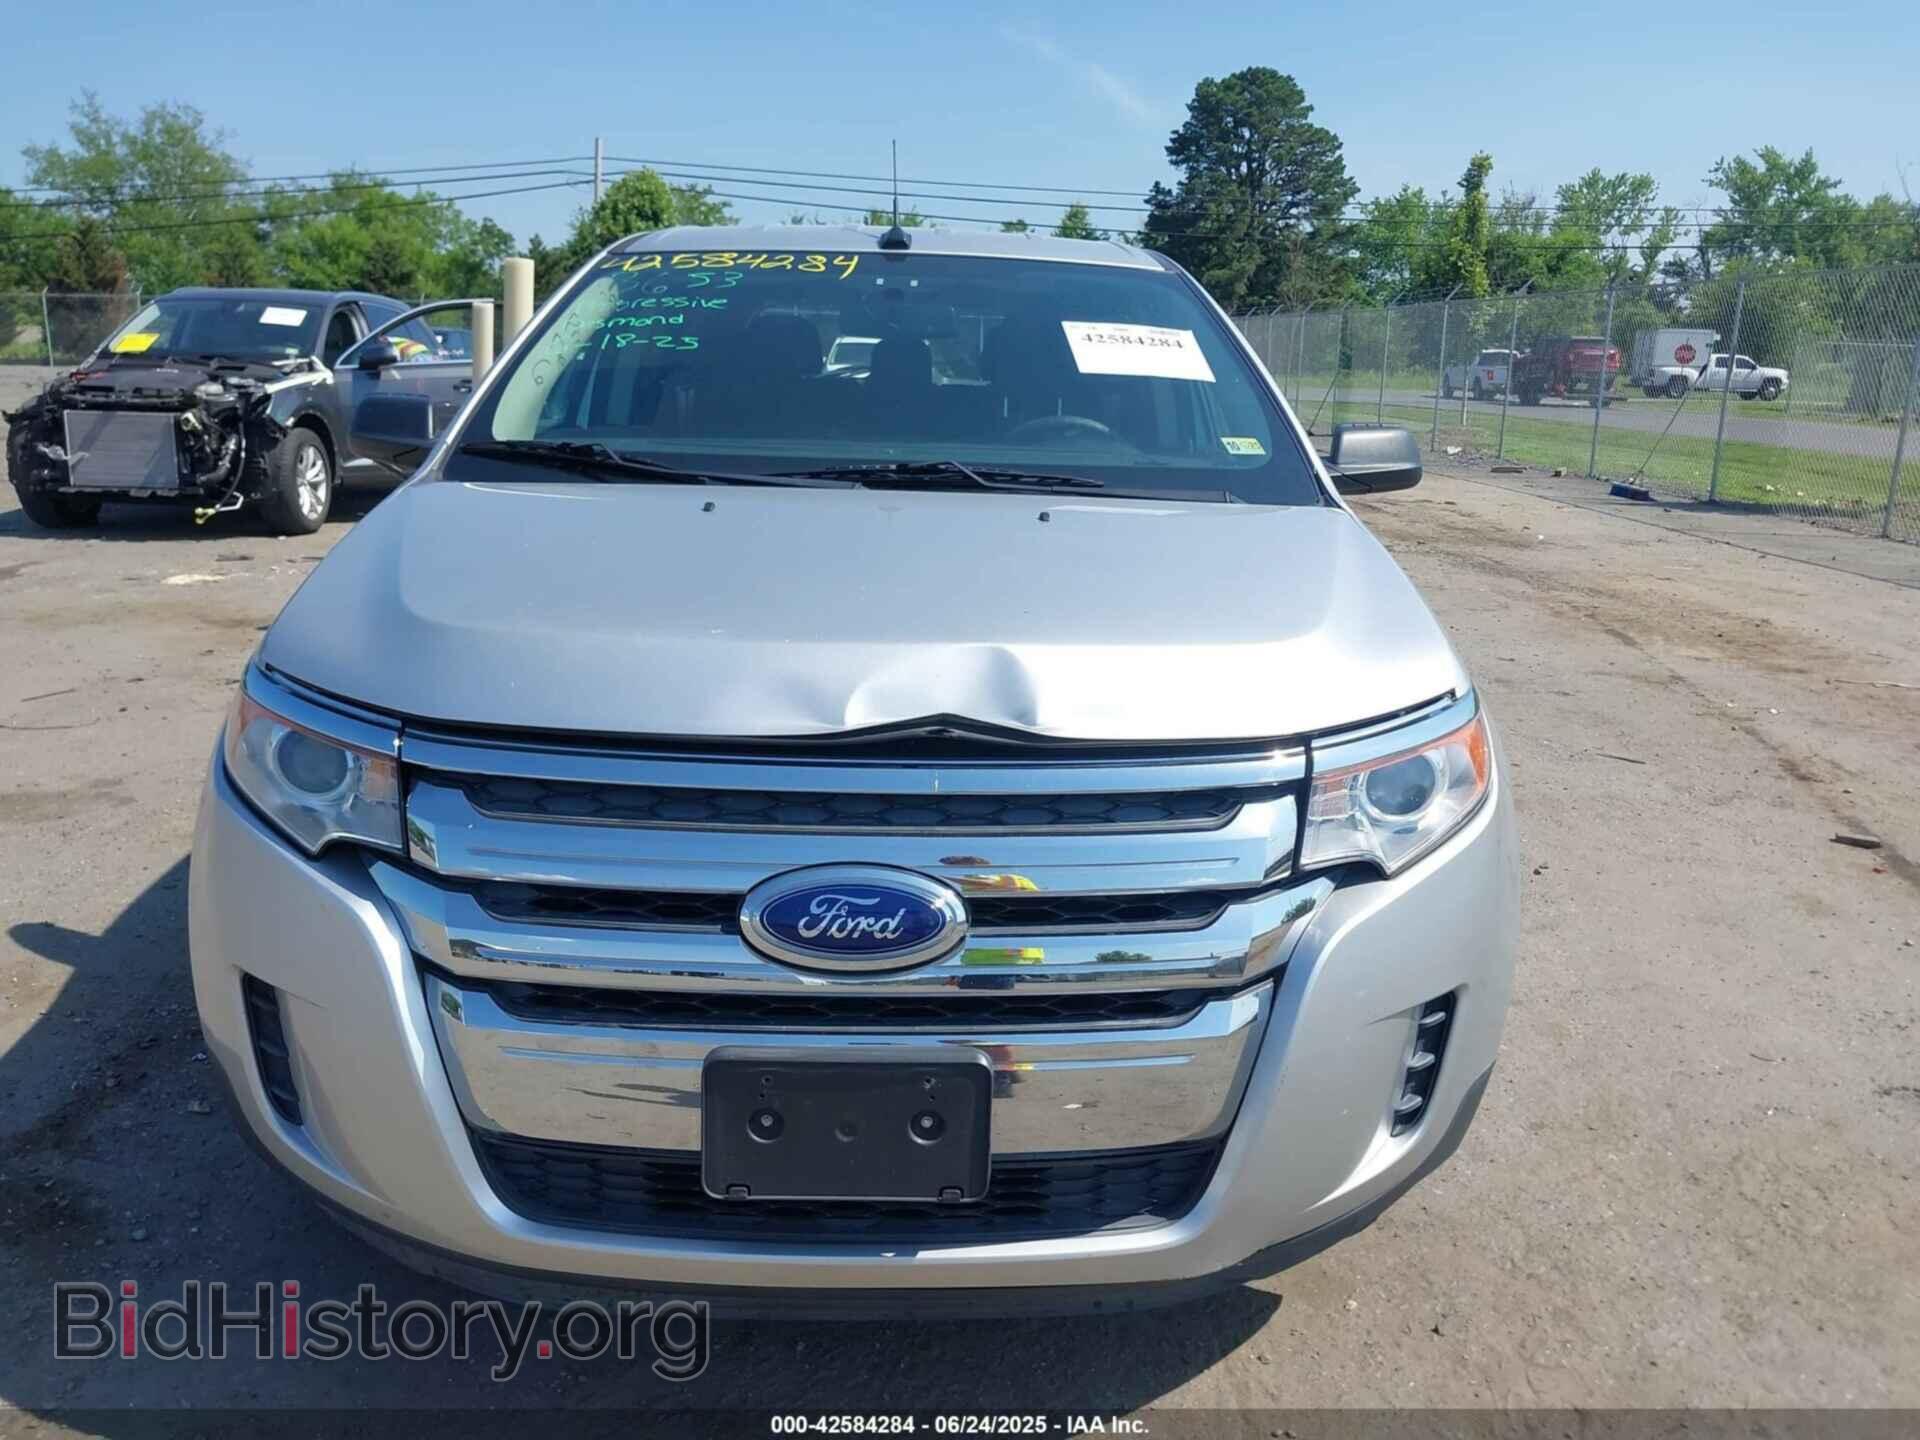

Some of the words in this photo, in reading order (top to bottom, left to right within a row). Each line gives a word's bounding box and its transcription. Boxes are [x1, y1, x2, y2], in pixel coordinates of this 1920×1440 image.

[600, 252, 859, 280] 42584284
[687, 271, 743, 288] 53
[1081, 332, 1183, 349] 42584284
[798, 894, 904, 939] Ford
